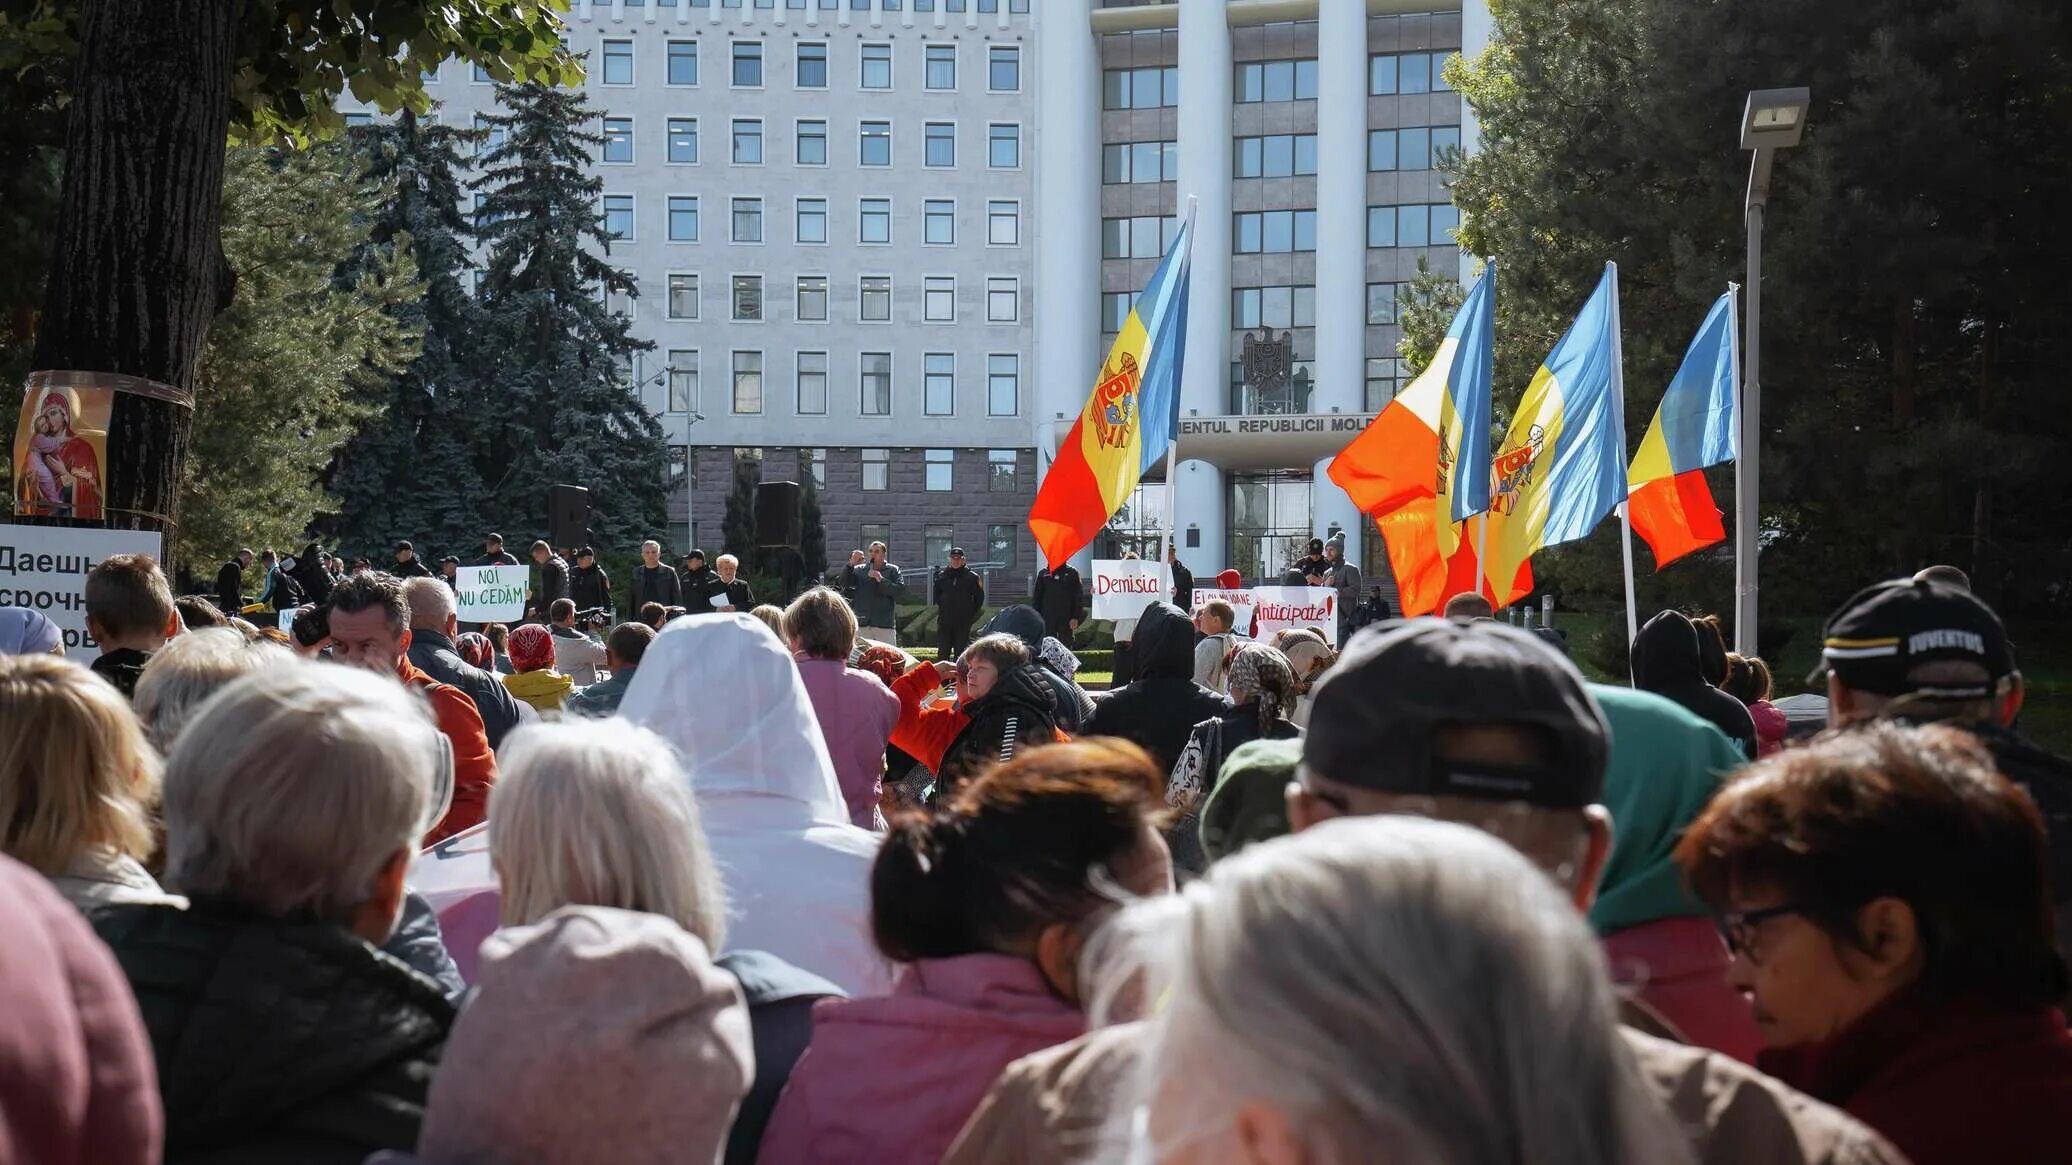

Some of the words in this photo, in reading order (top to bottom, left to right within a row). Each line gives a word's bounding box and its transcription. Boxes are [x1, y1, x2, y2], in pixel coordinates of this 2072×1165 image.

[1239, 419, 1324, 432] REPUBLICII
[478, 567, 500, 584] NOI
[1097, 574, 1159, 595] Demisia
[459, 591, 474, 606] NU
[1908, 629, 1985, 655] JUVENTUS
